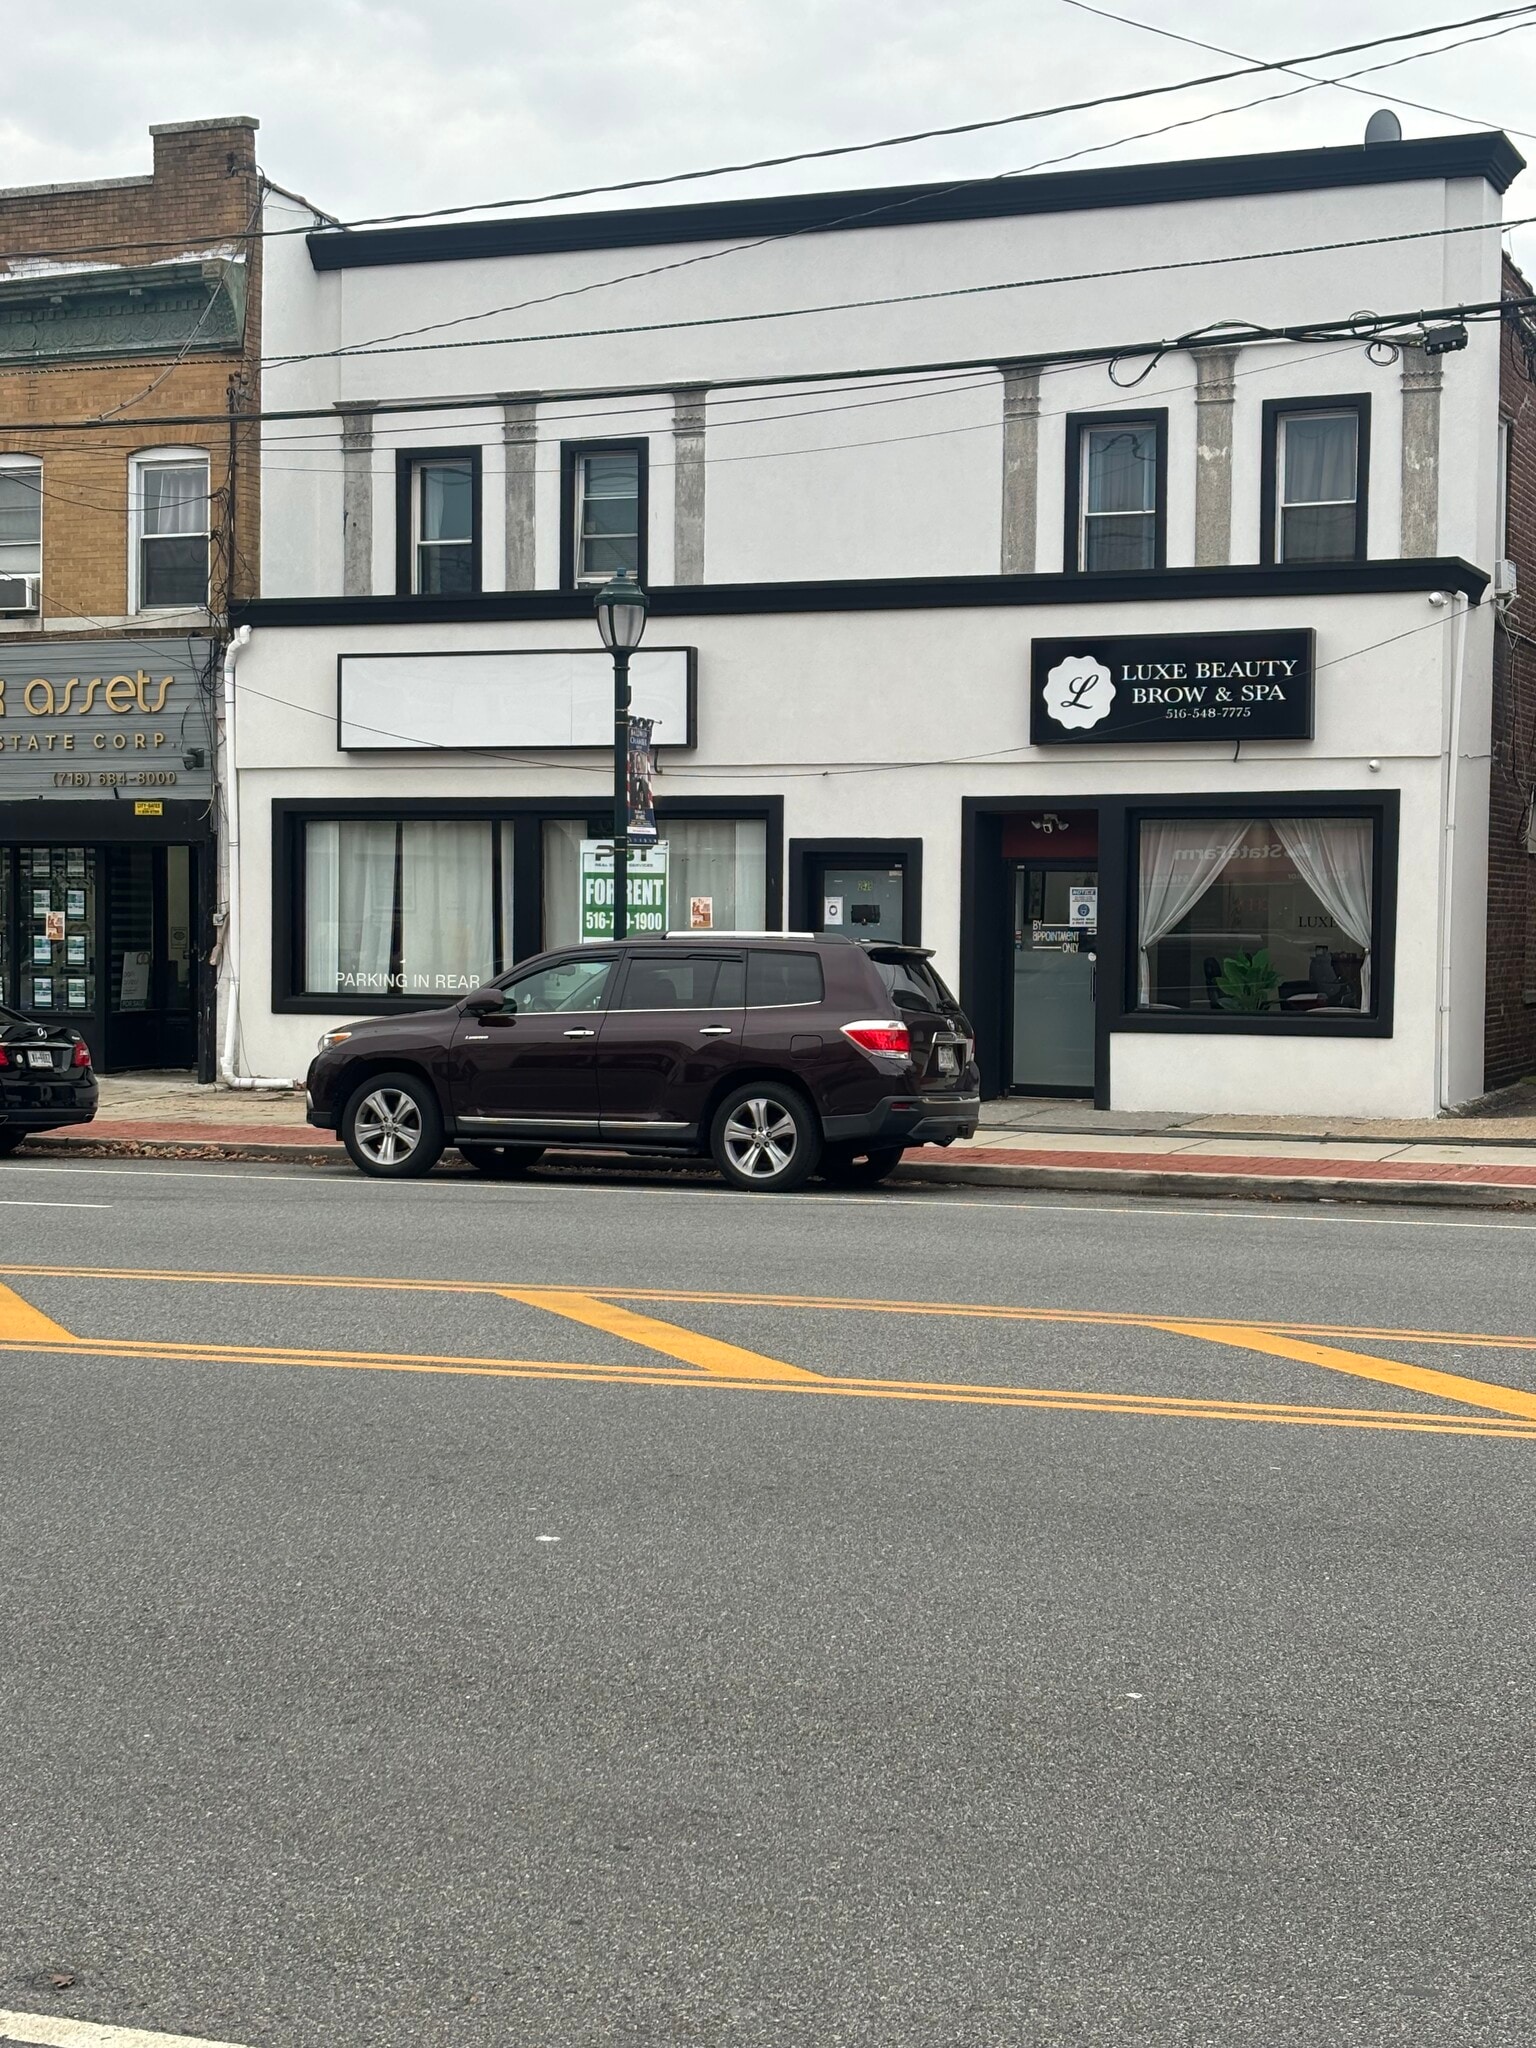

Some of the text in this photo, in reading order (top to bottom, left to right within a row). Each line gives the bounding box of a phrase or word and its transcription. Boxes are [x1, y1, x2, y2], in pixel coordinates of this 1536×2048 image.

[1121, 660, 1298, 681] LUXE BEAUTY
[24, 669, 174, 715] assets
[1060, 674, 1099, 709] L
[1132, 684, 1287, 704] BROW & SPA
[1165, 707, 1251, 719] 516-548-7775
[53, 771, 177, 787] (718) 684-8000
[586, 878, 614, 905] FOR
[586, 912, 662, 930] 516-7-1900
[1032, 920, 1042, 930] BY
[1062, 942, 1080, 953] ONLY
[335, 972, 480, 989] PARKING IN REAR
